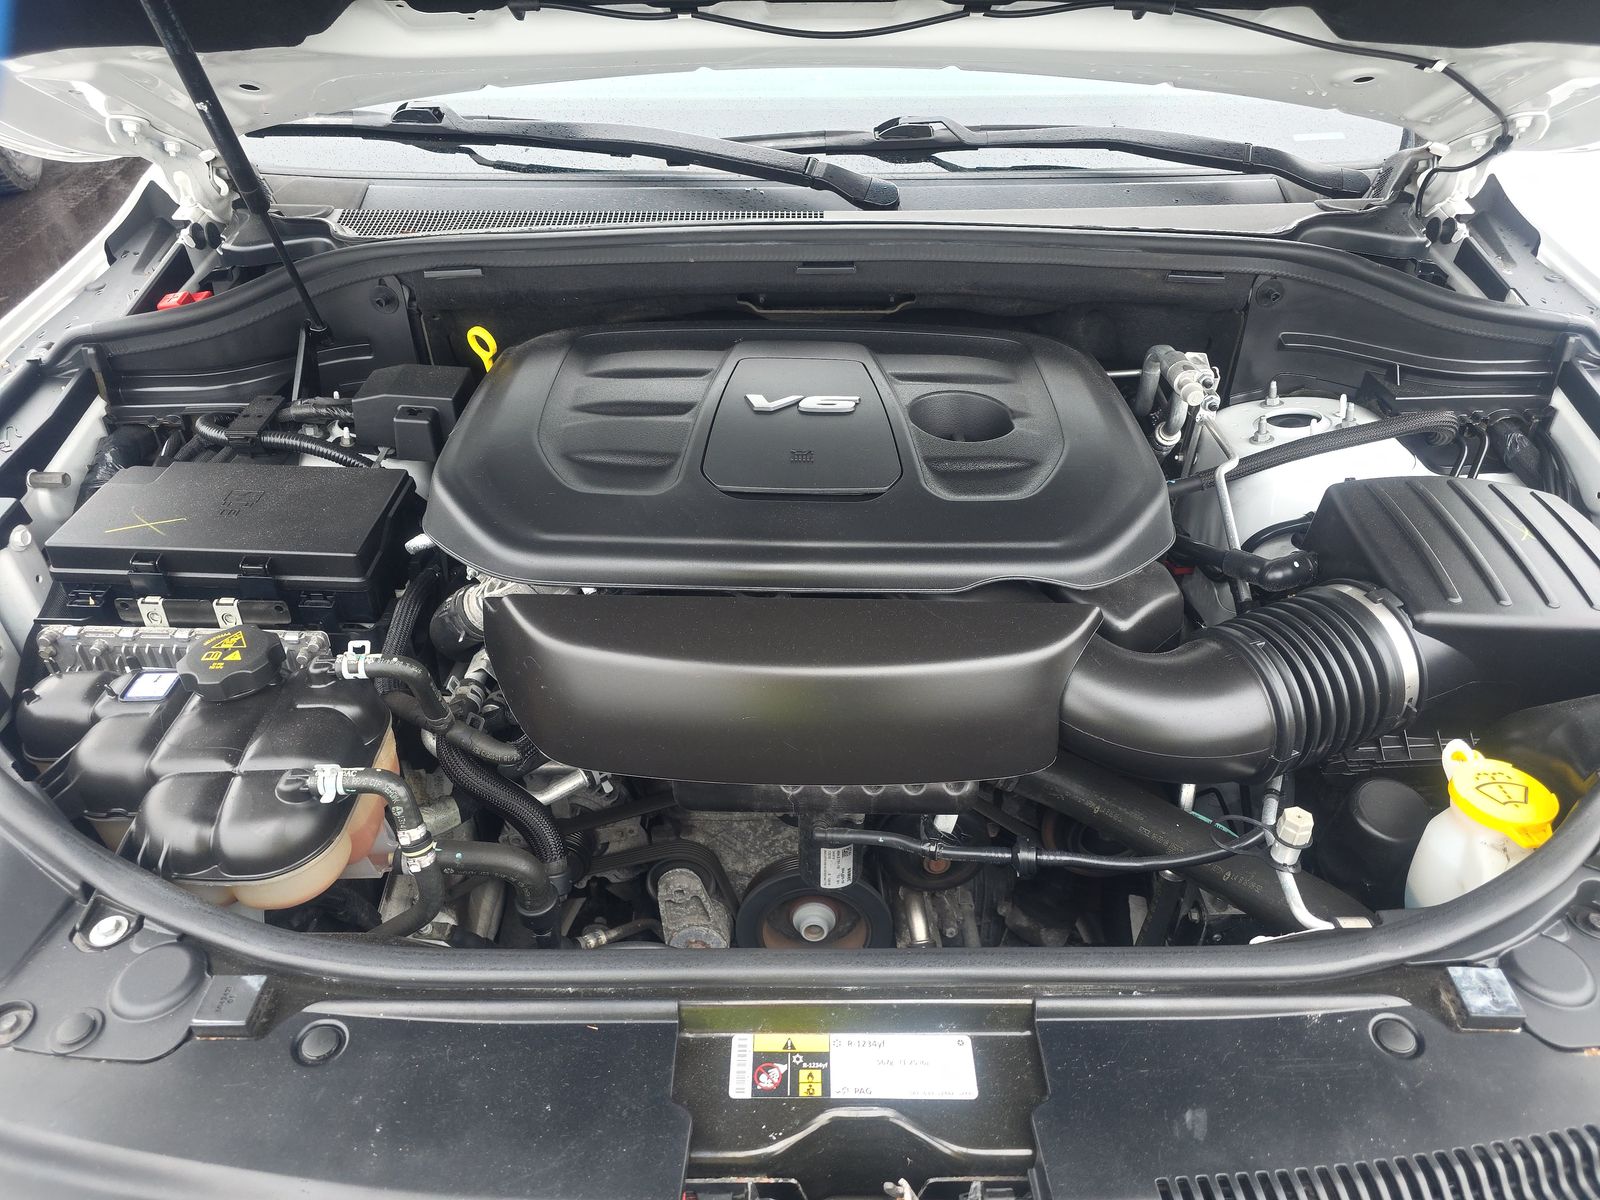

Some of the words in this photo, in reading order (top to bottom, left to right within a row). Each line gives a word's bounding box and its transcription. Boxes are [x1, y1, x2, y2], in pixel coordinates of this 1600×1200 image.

[743, 394, 861, 412] V6
[847, 1039, 885, 1048] R-1234yf
[802, 1061, 828, 1069] R-1234yf
[854, 1087, 872, 1096] PAG
